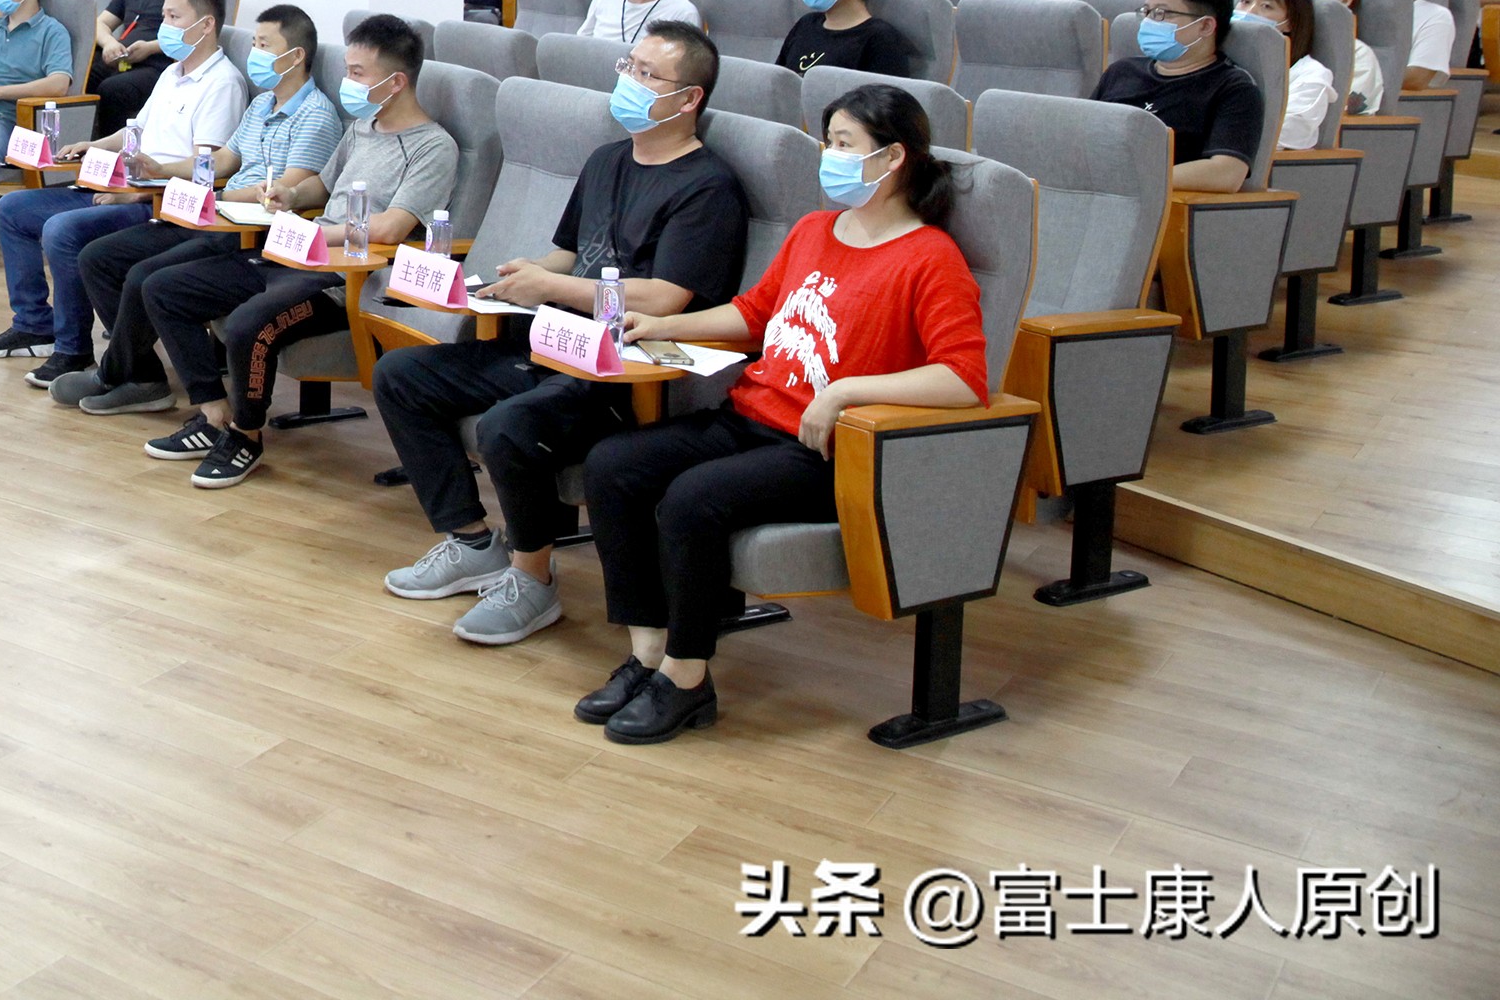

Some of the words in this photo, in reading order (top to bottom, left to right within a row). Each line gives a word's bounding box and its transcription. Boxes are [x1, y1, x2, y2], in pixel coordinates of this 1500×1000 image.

[12, 137, 37, 157] 主管席
[84, 158, 110, 178] 主管席
[168, 188, 198, 213] 主管席
[273, 226, 306, 252] 主管席
[398, 260, 445, 293] 主管席
[538, 322, 591, 359] 主管席
